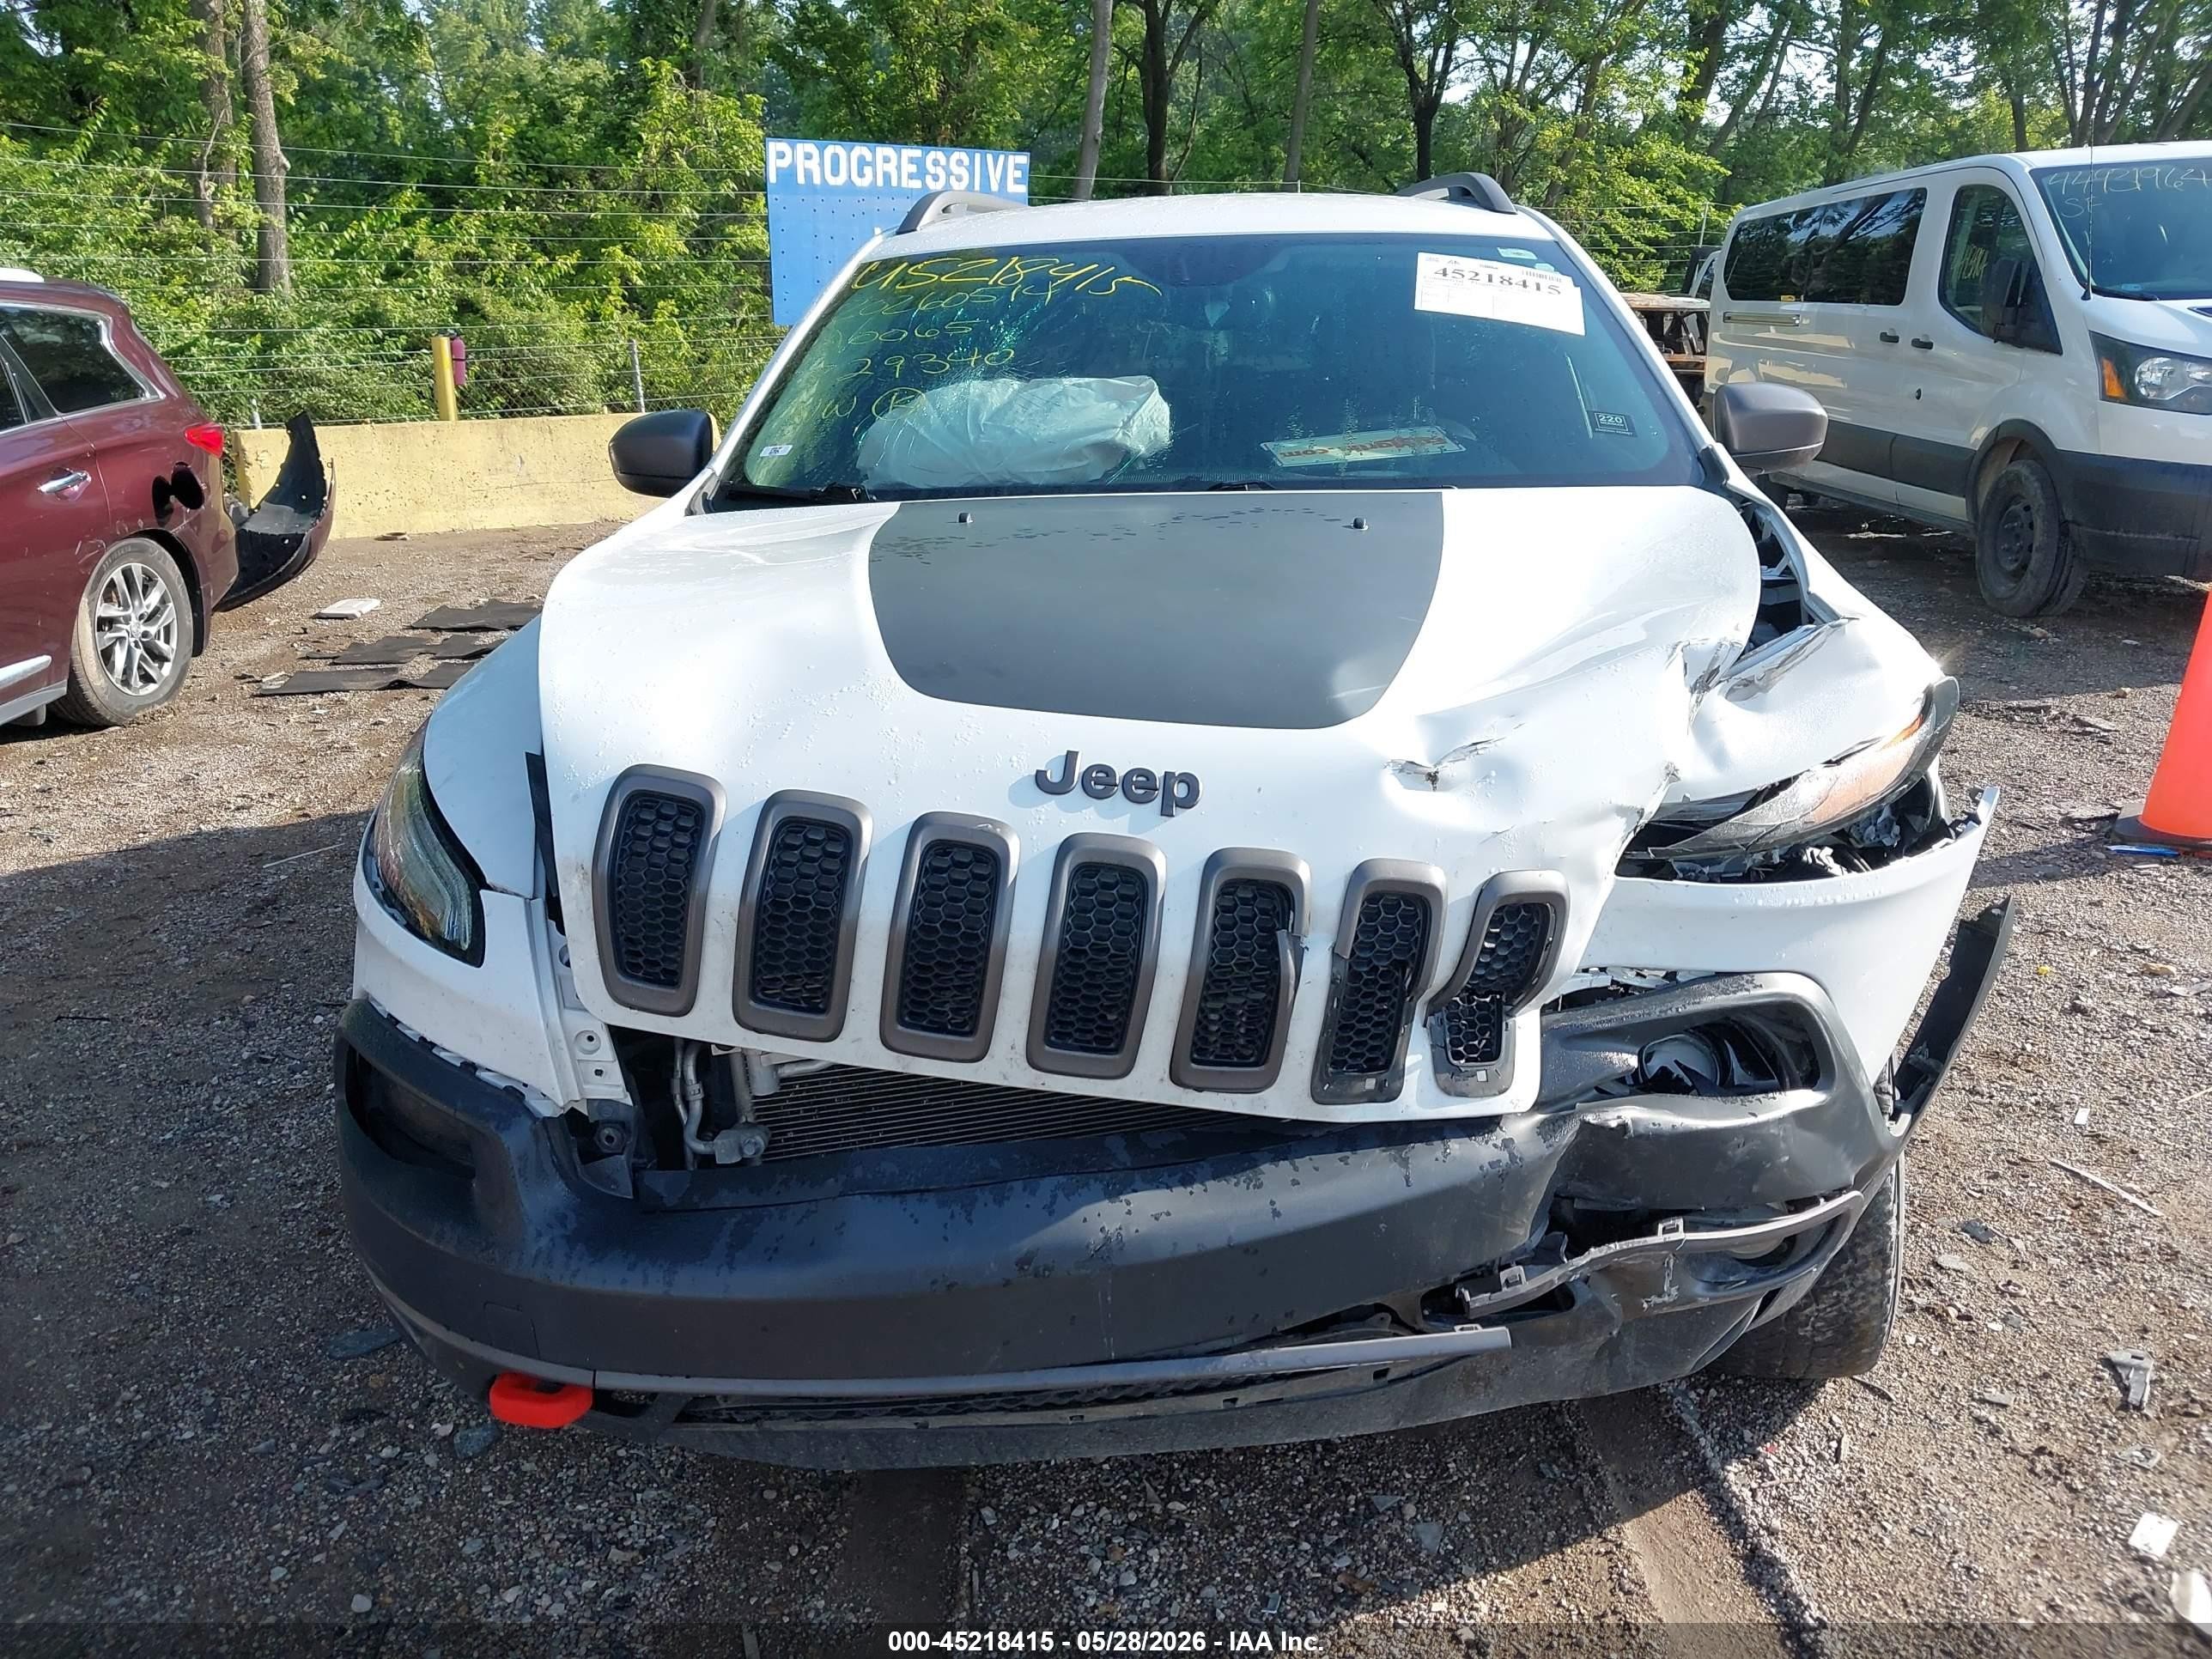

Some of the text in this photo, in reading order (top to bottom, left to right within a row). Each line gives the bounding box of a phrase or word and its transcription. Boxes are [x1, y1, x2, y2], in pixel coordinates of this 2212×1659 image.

[769, 142, 1029, 193] PROGRESSIVE
[1434, 267, 1561, 295] 45218415
[1598, 414, 1623, 423] 220
[1035, 750, 1201, 817] Jeep
